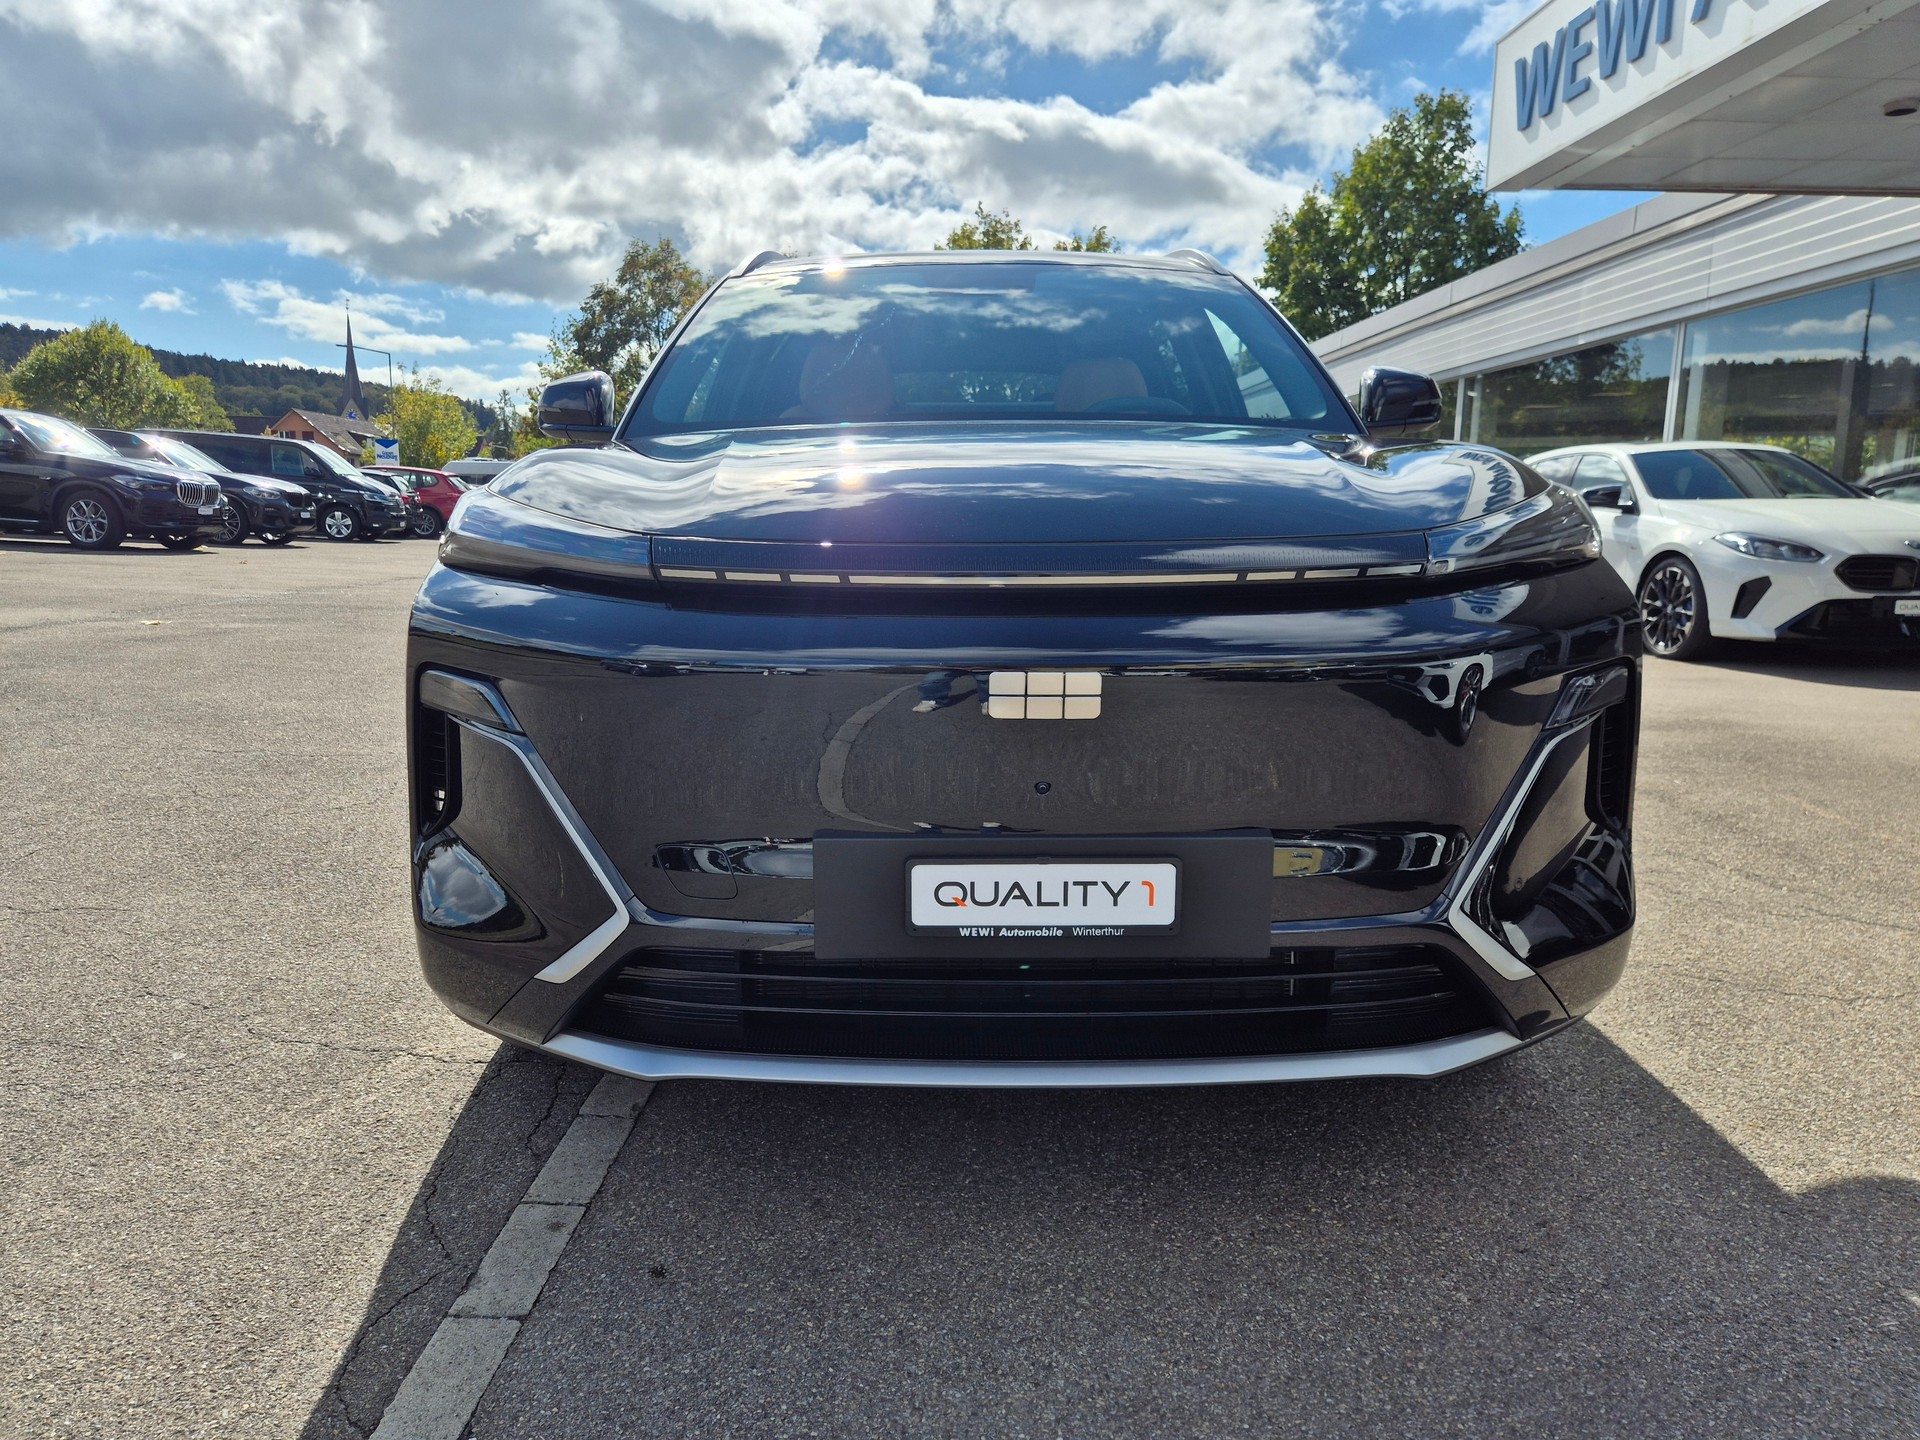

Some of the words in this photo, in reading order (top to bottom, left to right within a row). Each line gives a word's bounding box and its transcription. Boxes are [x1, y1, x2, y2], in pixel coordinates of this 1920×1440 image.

[933, 880, 1131, 907] QUALITY
[1141, 880, 1155, 907] 1
[998, 927, 1064, 937] Automobile
[1072, 927, 1125, 936] Winterthur
